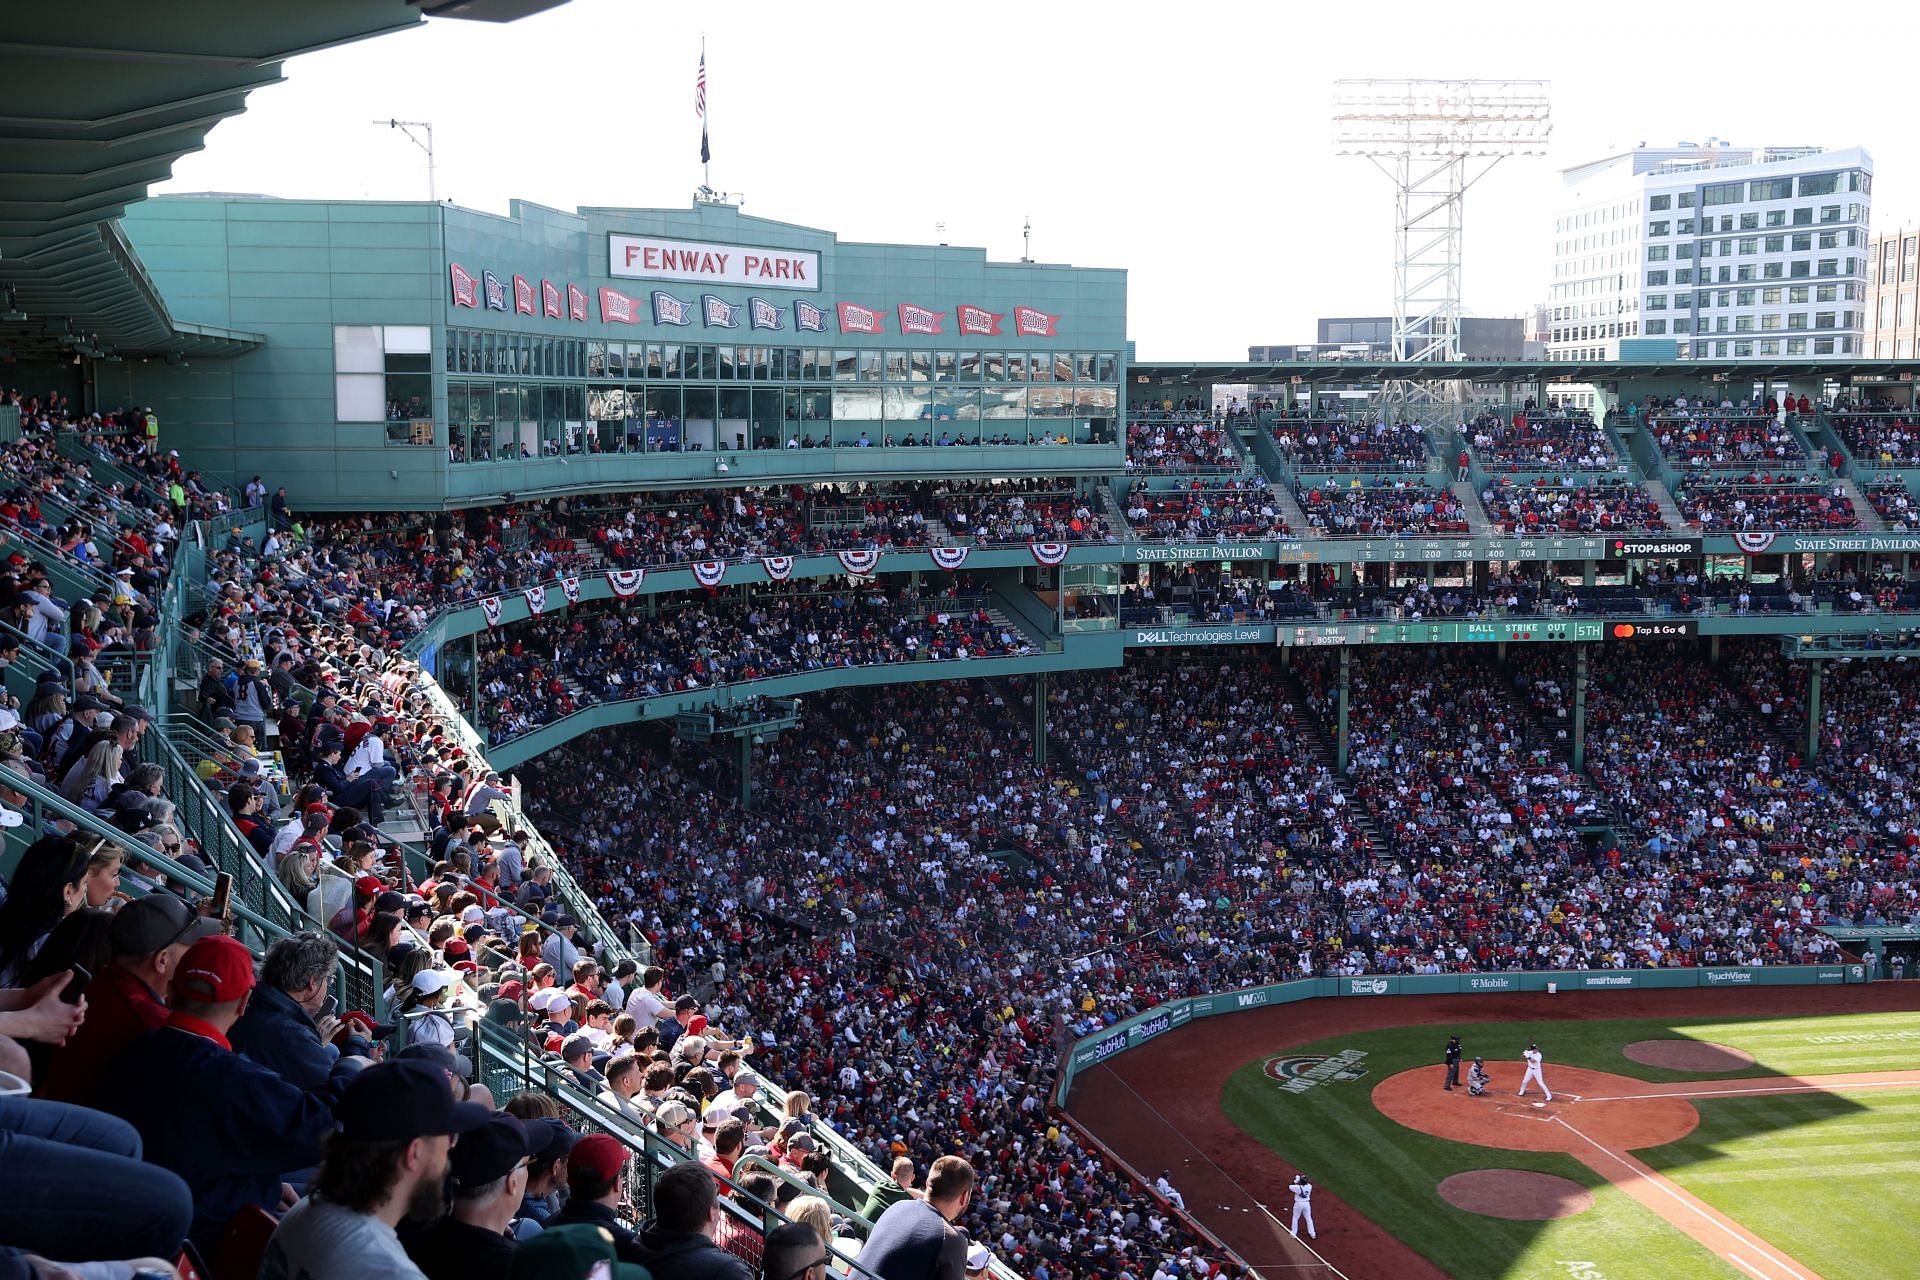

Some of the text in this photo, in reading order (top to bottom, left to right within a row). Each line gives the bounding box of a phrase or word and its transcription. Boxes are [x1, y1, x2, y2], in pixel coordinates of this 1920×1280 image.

[625, 245, 806, 280] FENWAY PARK
[844, 310, 874, 327] 2004
[904, 310, 935, 328] 2007
[964, 312, 993, 329] 2013
[1020, 313, 1049, 330] 2018
[1794, 538, 1920, 550] STATE STREET PAVILION
[1136, 548, 1169, 560] STATE
[1212, 547, 1262, 558] PAVILION
[1365, 551, 1371, 559] 5
[1394, 551, 1405, 559] 23
[1453, 550, 1473, 558] .304
[1297, 628, 1305, 636] 41
[1469, 623, 1566, 632] BALL STRIKE OUT
[1578, 625, 1600, 637] 5TH
[1635, 626, 1676, 635] Tap & Go
[1137, 629, 1260, 644] DELL Technologies Level
[1317, 636, 1346, 644] BOSTON
[1401, 634, 1407, 642] 4
[1352, 979, 1373, 987] Ninety
[1479, 978, 1508, 988] Mobile
[1586, 976, 1632, 985] smartwater
[1706, 972, 1751, 983] TouchView
[1238, 991, 1266, 1006] WM
[1140, 1017, 1168, 1038] StubHub
[1095, 1035, 1126, 1059] StubHub
